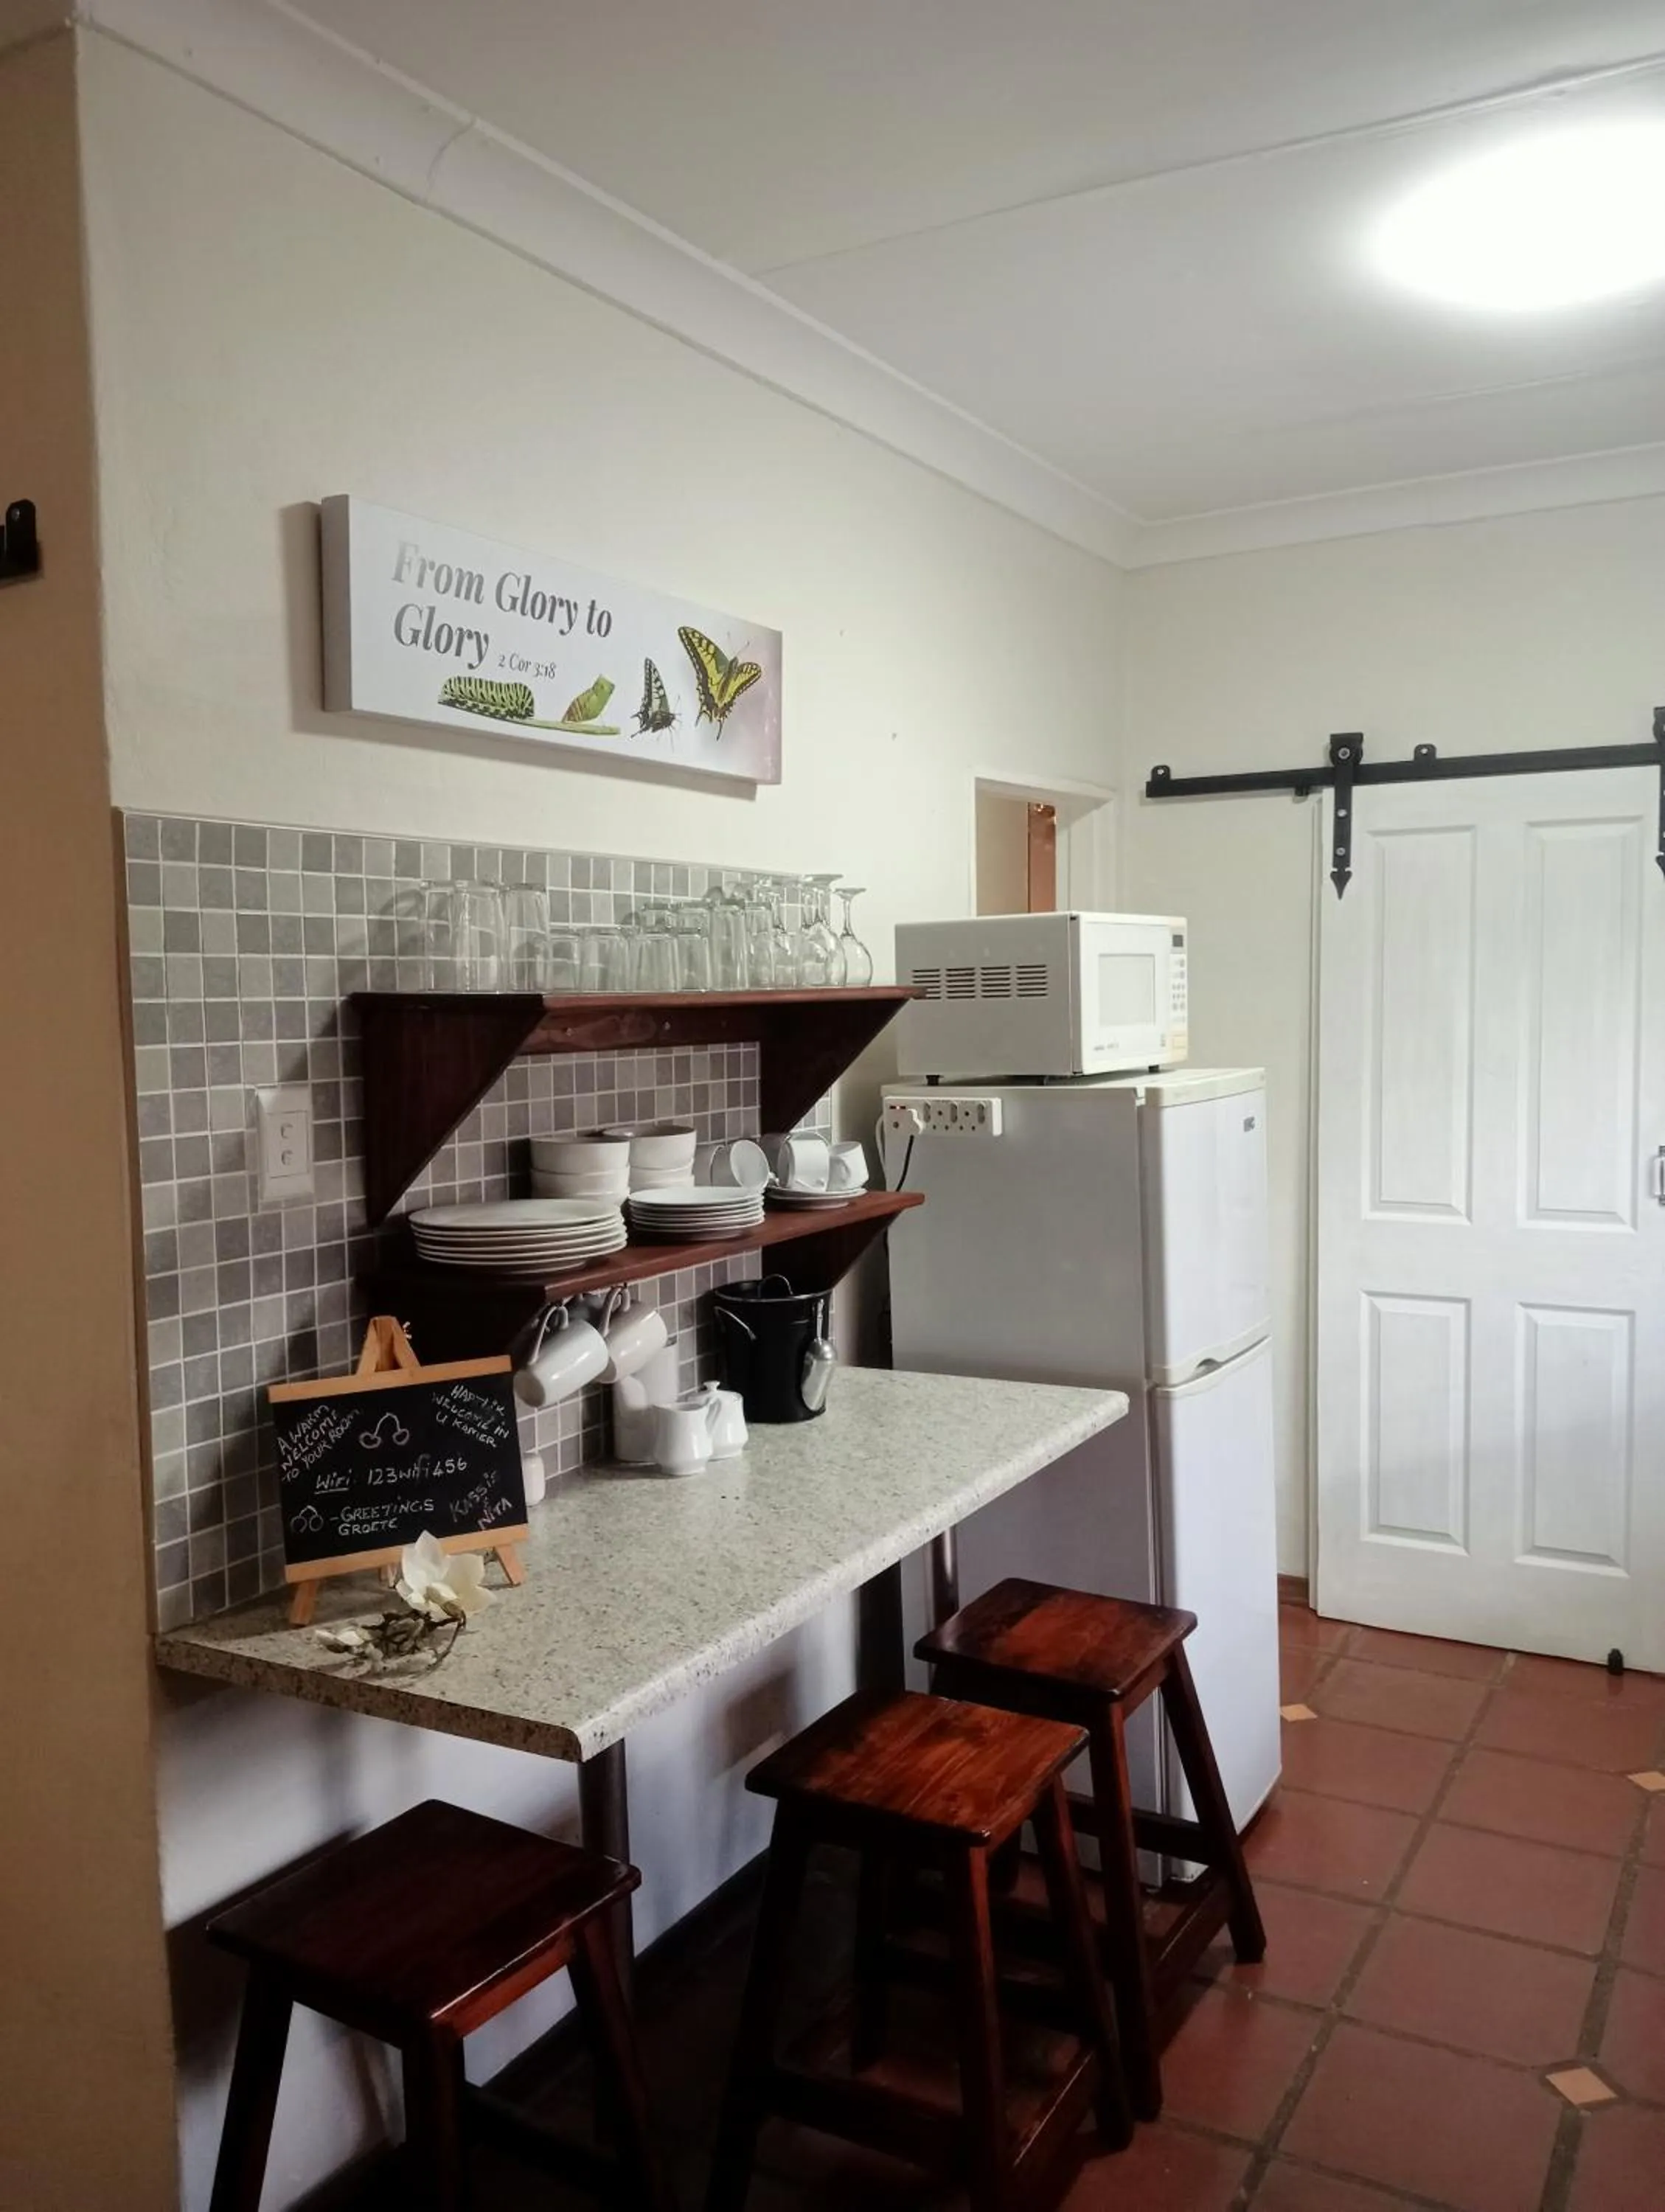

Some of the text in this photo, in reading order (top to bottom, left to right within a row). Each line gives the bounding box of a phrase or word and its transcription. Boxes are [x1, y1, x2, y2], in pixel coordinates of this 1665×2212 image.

[391, 540, 613, 638] From Glory to
[394, 603, 490, 669] Glory
[498, 653, 556, 680] 2 Cor 3:18
[277, 1405, 330, 1456] A WARM
[301, 1439, 333, 1470] YOUR
